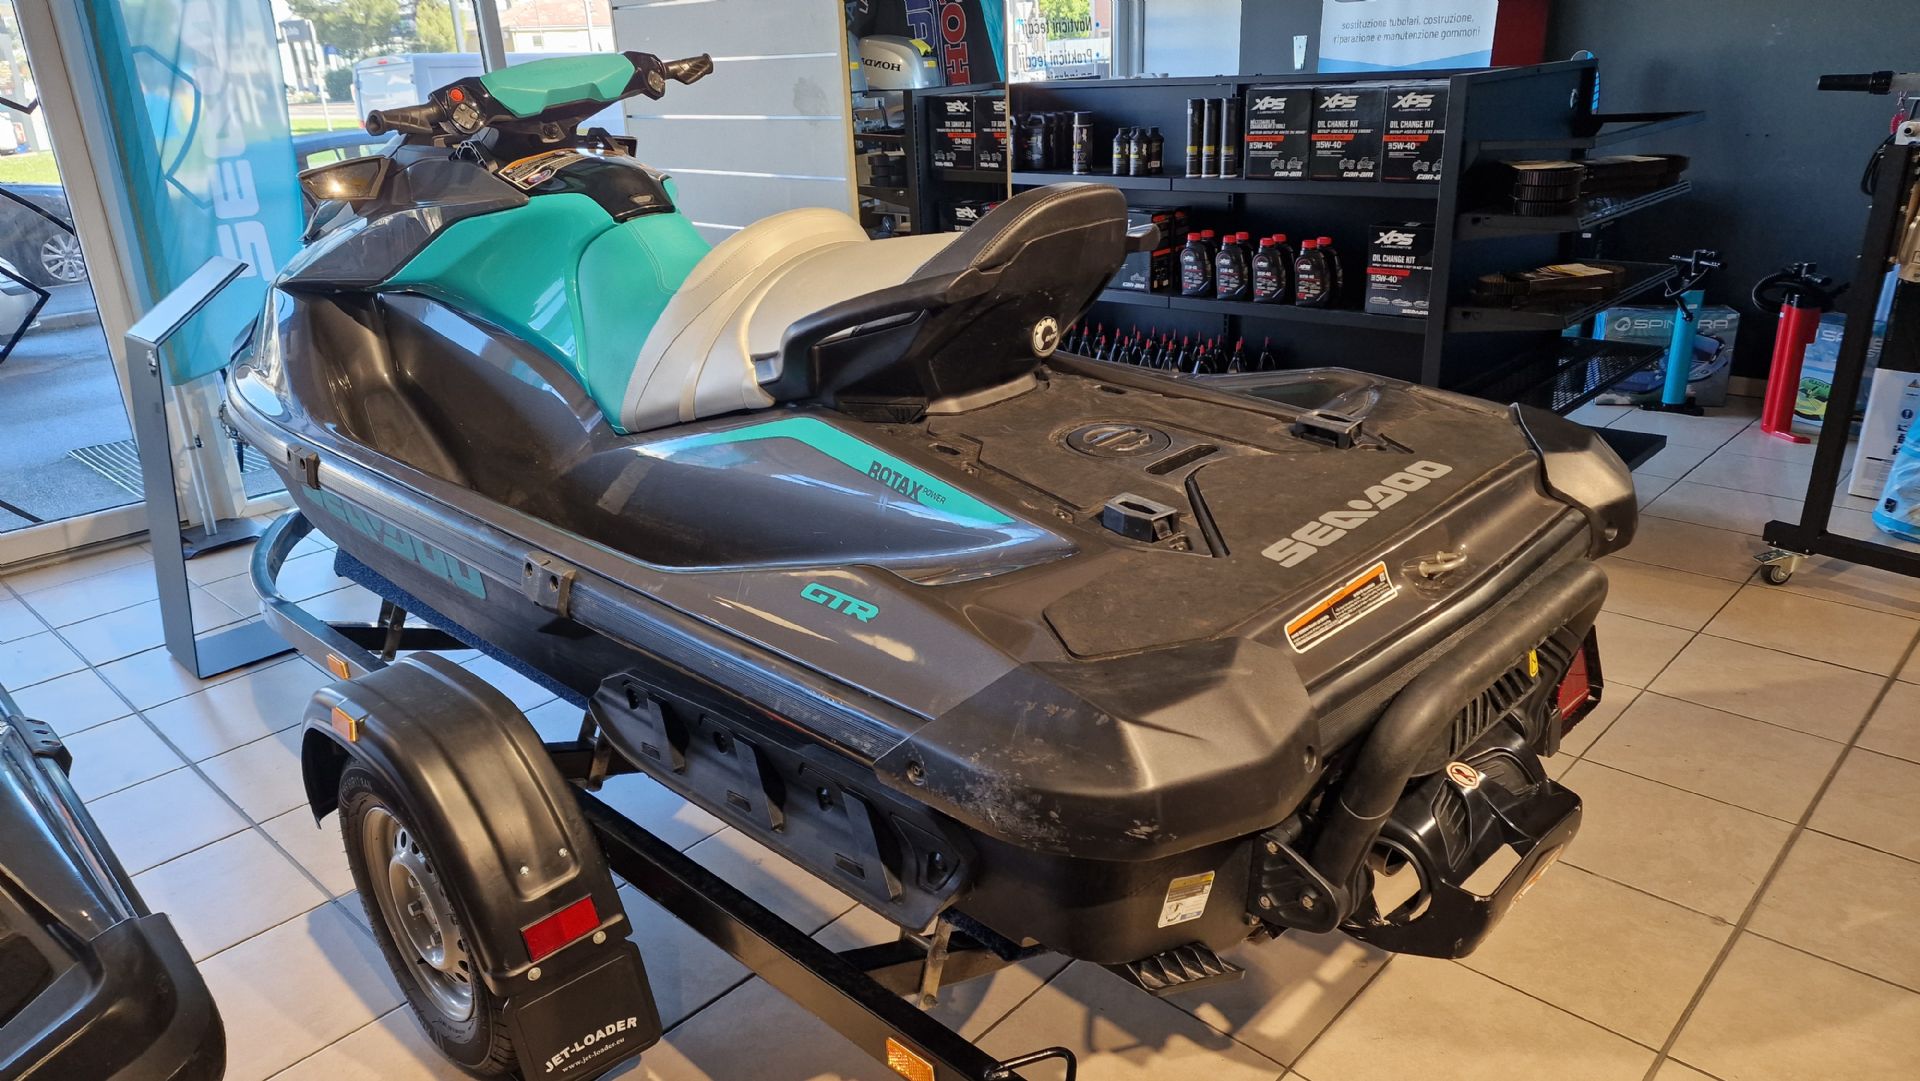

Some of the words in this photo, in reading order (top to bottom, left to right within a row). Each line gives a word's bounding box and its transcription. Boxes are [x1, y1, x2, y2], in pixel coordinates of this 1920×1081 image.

[1341, 20, 1387, 30] sostituzione
[1333, 33, 1375, 45] riparazione
[1383, 30, 1439, 41] manutenzione
[1440, 26, 1481, 41] gommoni
[1251, 96, 1287, 110] XPS
[1320, 93, 1359, 108] XPS
[1392, 92, 1435, 108] XPS
[1317, 120, 1326, 128] OIL
[1327, 120, 1349, 128] CHANGE
[1350, 120, 1359, 128] KIT
[1389, 120, 1399, 129] OIL
[1400, 120, 1424, 129] CHANGE
[1425, 120, 1434, 128] KIT
[1374, 230, 1416, 245] XPS
[1372, 254, 1381, 262] OIL
[1382, 255, 1405, 263] CHANGE
[1406, 256, 1416, 264] KIT
[1634, 319, 1729, 329] SPINRA
[866, 460, 922, 502] ROTAX
[923, 487, 947, 505] POWER
[800, 581, 880, 623] GTR
[545, 1016, 637, 1073] JET-LOADER
[562, 1037, 625, 1073] www.jet-loader.eu
